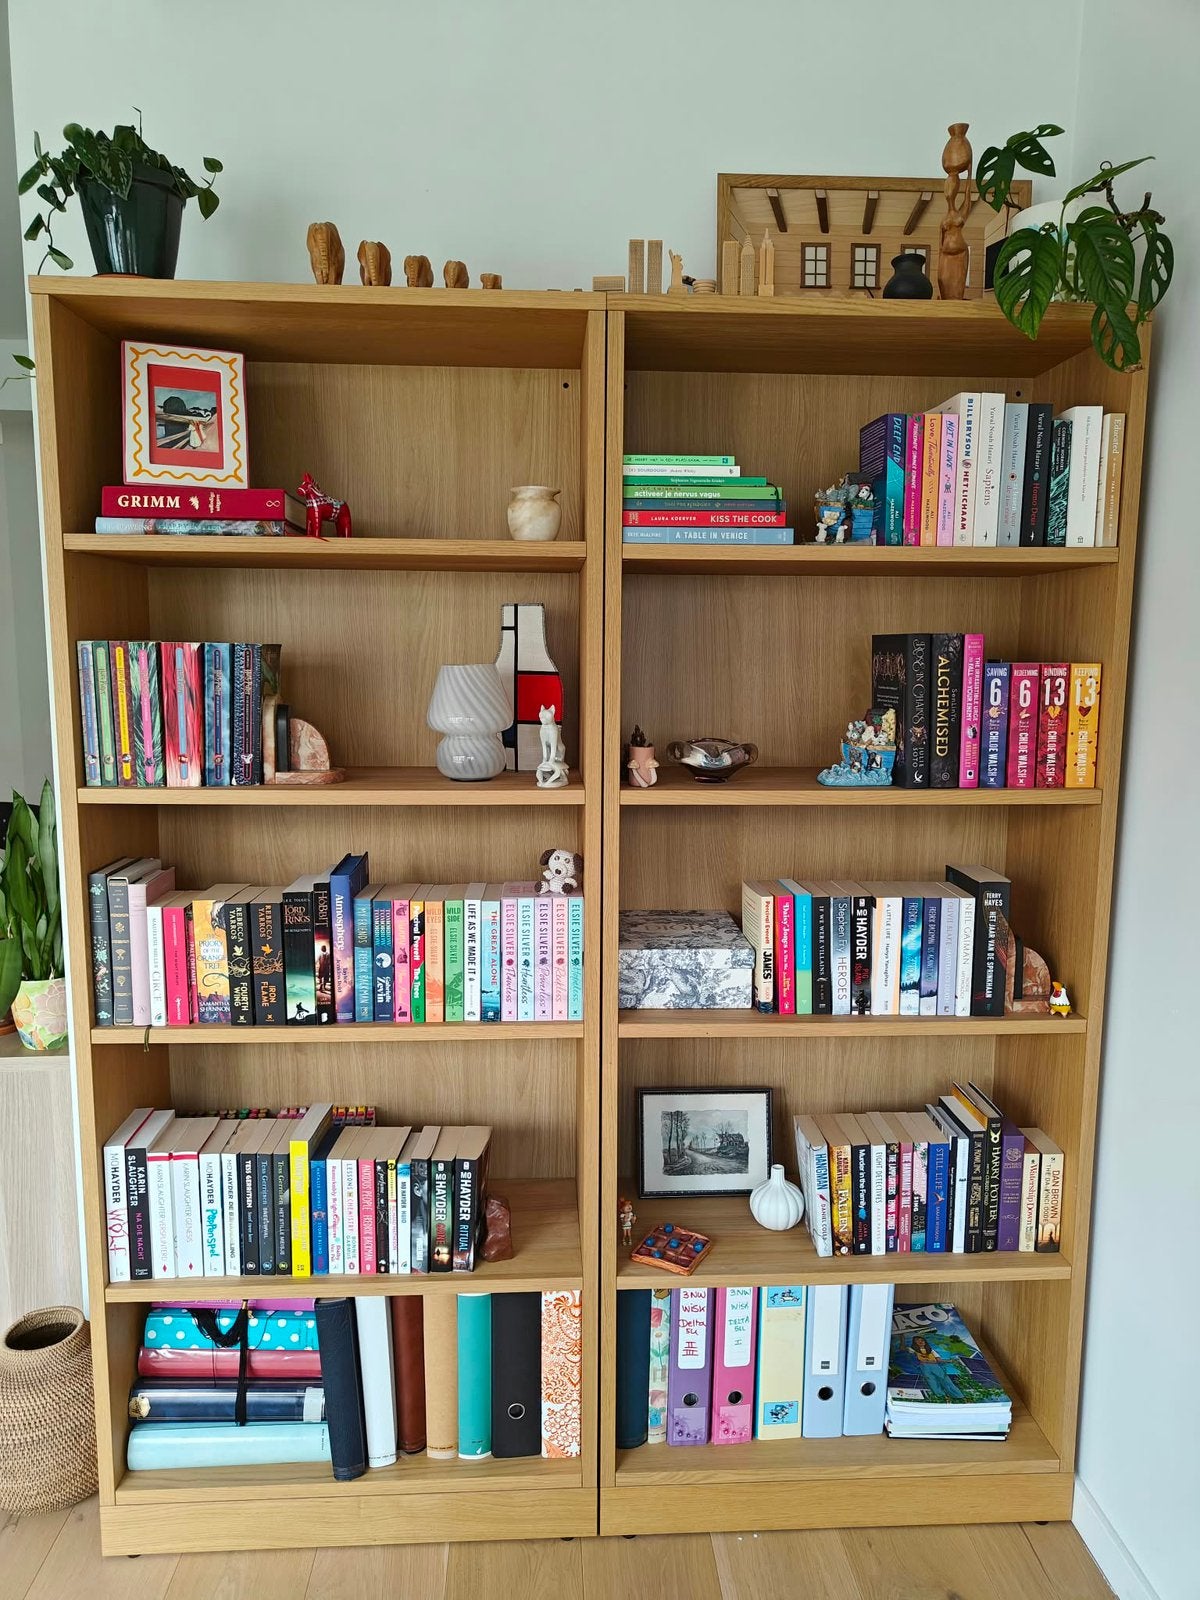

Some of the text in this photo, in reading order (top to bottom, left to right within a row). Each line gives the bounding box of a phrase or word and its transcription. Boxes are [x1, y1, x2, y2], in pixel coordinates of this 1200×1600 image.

[893, 417, 902, 462] DEEP END
[946, 420, 954, 436] NOT
[964, 420, 972, 457] BRYSON
[1112, 419, 1122, 454] Educated
[946, 439, 954, 447] IN
[665, 490, 672, 498] je
[700, 491, 720, 499] vagus
[982, 468, 994, 506] Sapiens
[117, 495, 181, 508] GRIMM
[1030, 482, 1040, 526] Homo Deus
[710, 515, 730, 523] KISS
[751, 516, 777, 524] COOK
[676, 530, 748, 540] A TABLE IN VENICE
[986, 668, 1008, 677] SAVING
[936, 655, 951, 757] ALCHEMISED
[989, 678, 1001, 706] 6
[1019, 678, 1031, 708] 6
[1044, 678, 1066, 706] 13
[1074, 678, 1096, 706] 13
[988, 730, 999, 752] CHLOE
[1018, 732, 1028, 754] CHLOE
[1046, 730, 1057, 752] CHLOE
[987, 753, 998, 777] WALSH
[1017, 754, 1028, 778] WALSH
[1045, 753, 1056, 776] WALSH
[335, 894, 346, 950] Atmosphere
[468, 904, 476, 919] LIFE
[450, 928, 458, 943] ELSIE
[468, 922, 476, 930] AS
[468, 932, 476, 944] WE
[506, 904, 515, 956] ELSIE SILVER
[522, 904, 530, 956] ELSIE SILVER
[539, 904, 548, 955] ELSIE SILVER
[556, 904, 565, 955] ELSIE SILVER
[572, 904, 580, 955] ELSIE SILVER
[835, 902, 848, 952] Stephen Fry
[856, 918, 867, 960] HAYDER
[468, 946, 476, 966] MADE
[962, 927, 971, 966] GAIMAN
[762, 951, 772, 980] JAMES
[838, 956, 847, 1000] HEROES
[261, 981, 269, 1006] FLAME
[268, 985, 276, 1003] IRON
[376, 976, 385, 1003] Zevin
[985, 962, 994, 998] SPRINKHAAN
[240, 982, 248, 1011] FOURTH
[815, 1153, 828, 1190] HANGMAN
[936, 1148, 944, 1171] STILL
[128, 1155, 138, 1206] SLAUGHTER
[137, 1166, 146, 1194] KARIN
[988, 1147, 1000, 1223] HARRY POTTER
[1026, 1164, 1038, 1202] Watership
[435, 1181, 446, 1220] HAYDER
[459, 1179, 472, 1220] HAYDER
[858, 1189, 866, 1209] Family
[1050, 1170, 1060, 1219] DAN BROWN
[136, 1212, 142, 1222] NA
[837, 1188, 849, 1232] FALLEN
[458, 1224, 469, 1252] RITUAL
